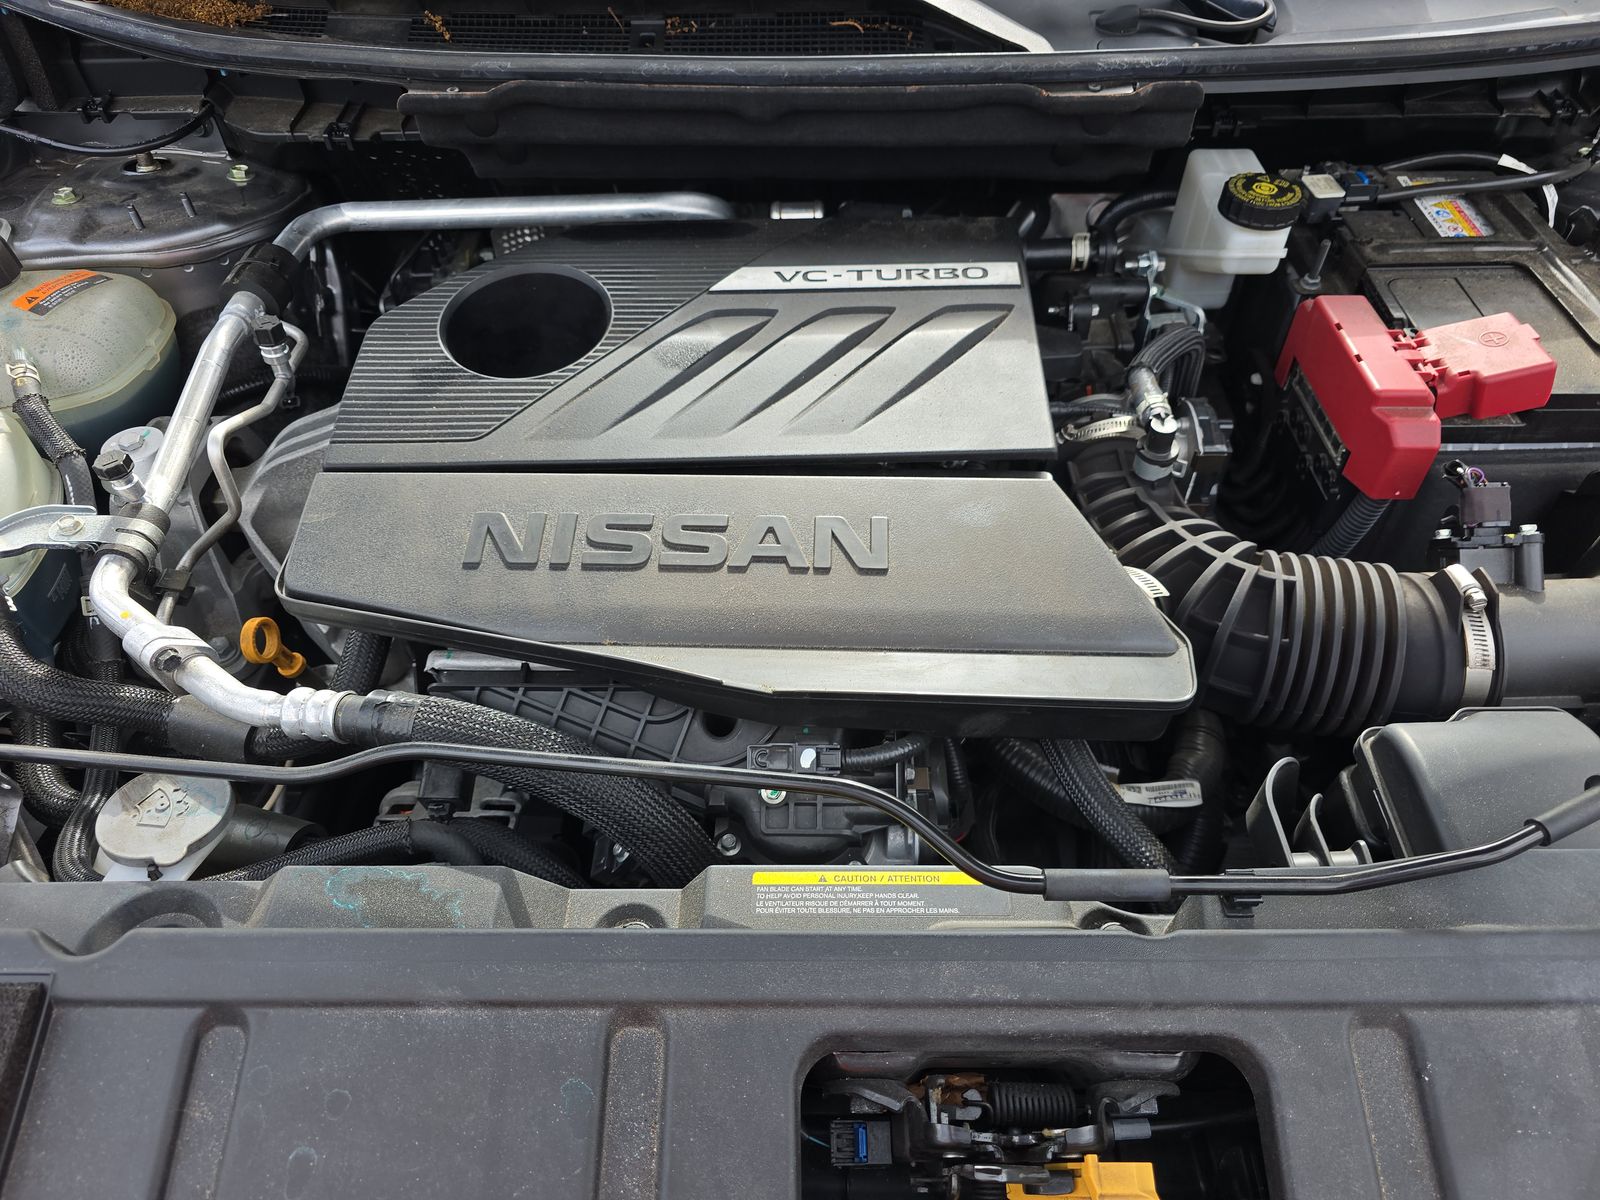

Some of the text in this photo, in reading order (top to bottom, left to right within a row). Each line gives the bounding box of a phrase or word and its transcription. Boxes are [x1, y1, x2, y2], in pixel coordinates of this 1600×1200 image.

[774, 267, 988, 282] VC-TURBO
[462, 512, 889, 574] NISSAN
[840, 899, 873, 907] DÉMARRER
[775, 906, 795, 914] ÉVITER
